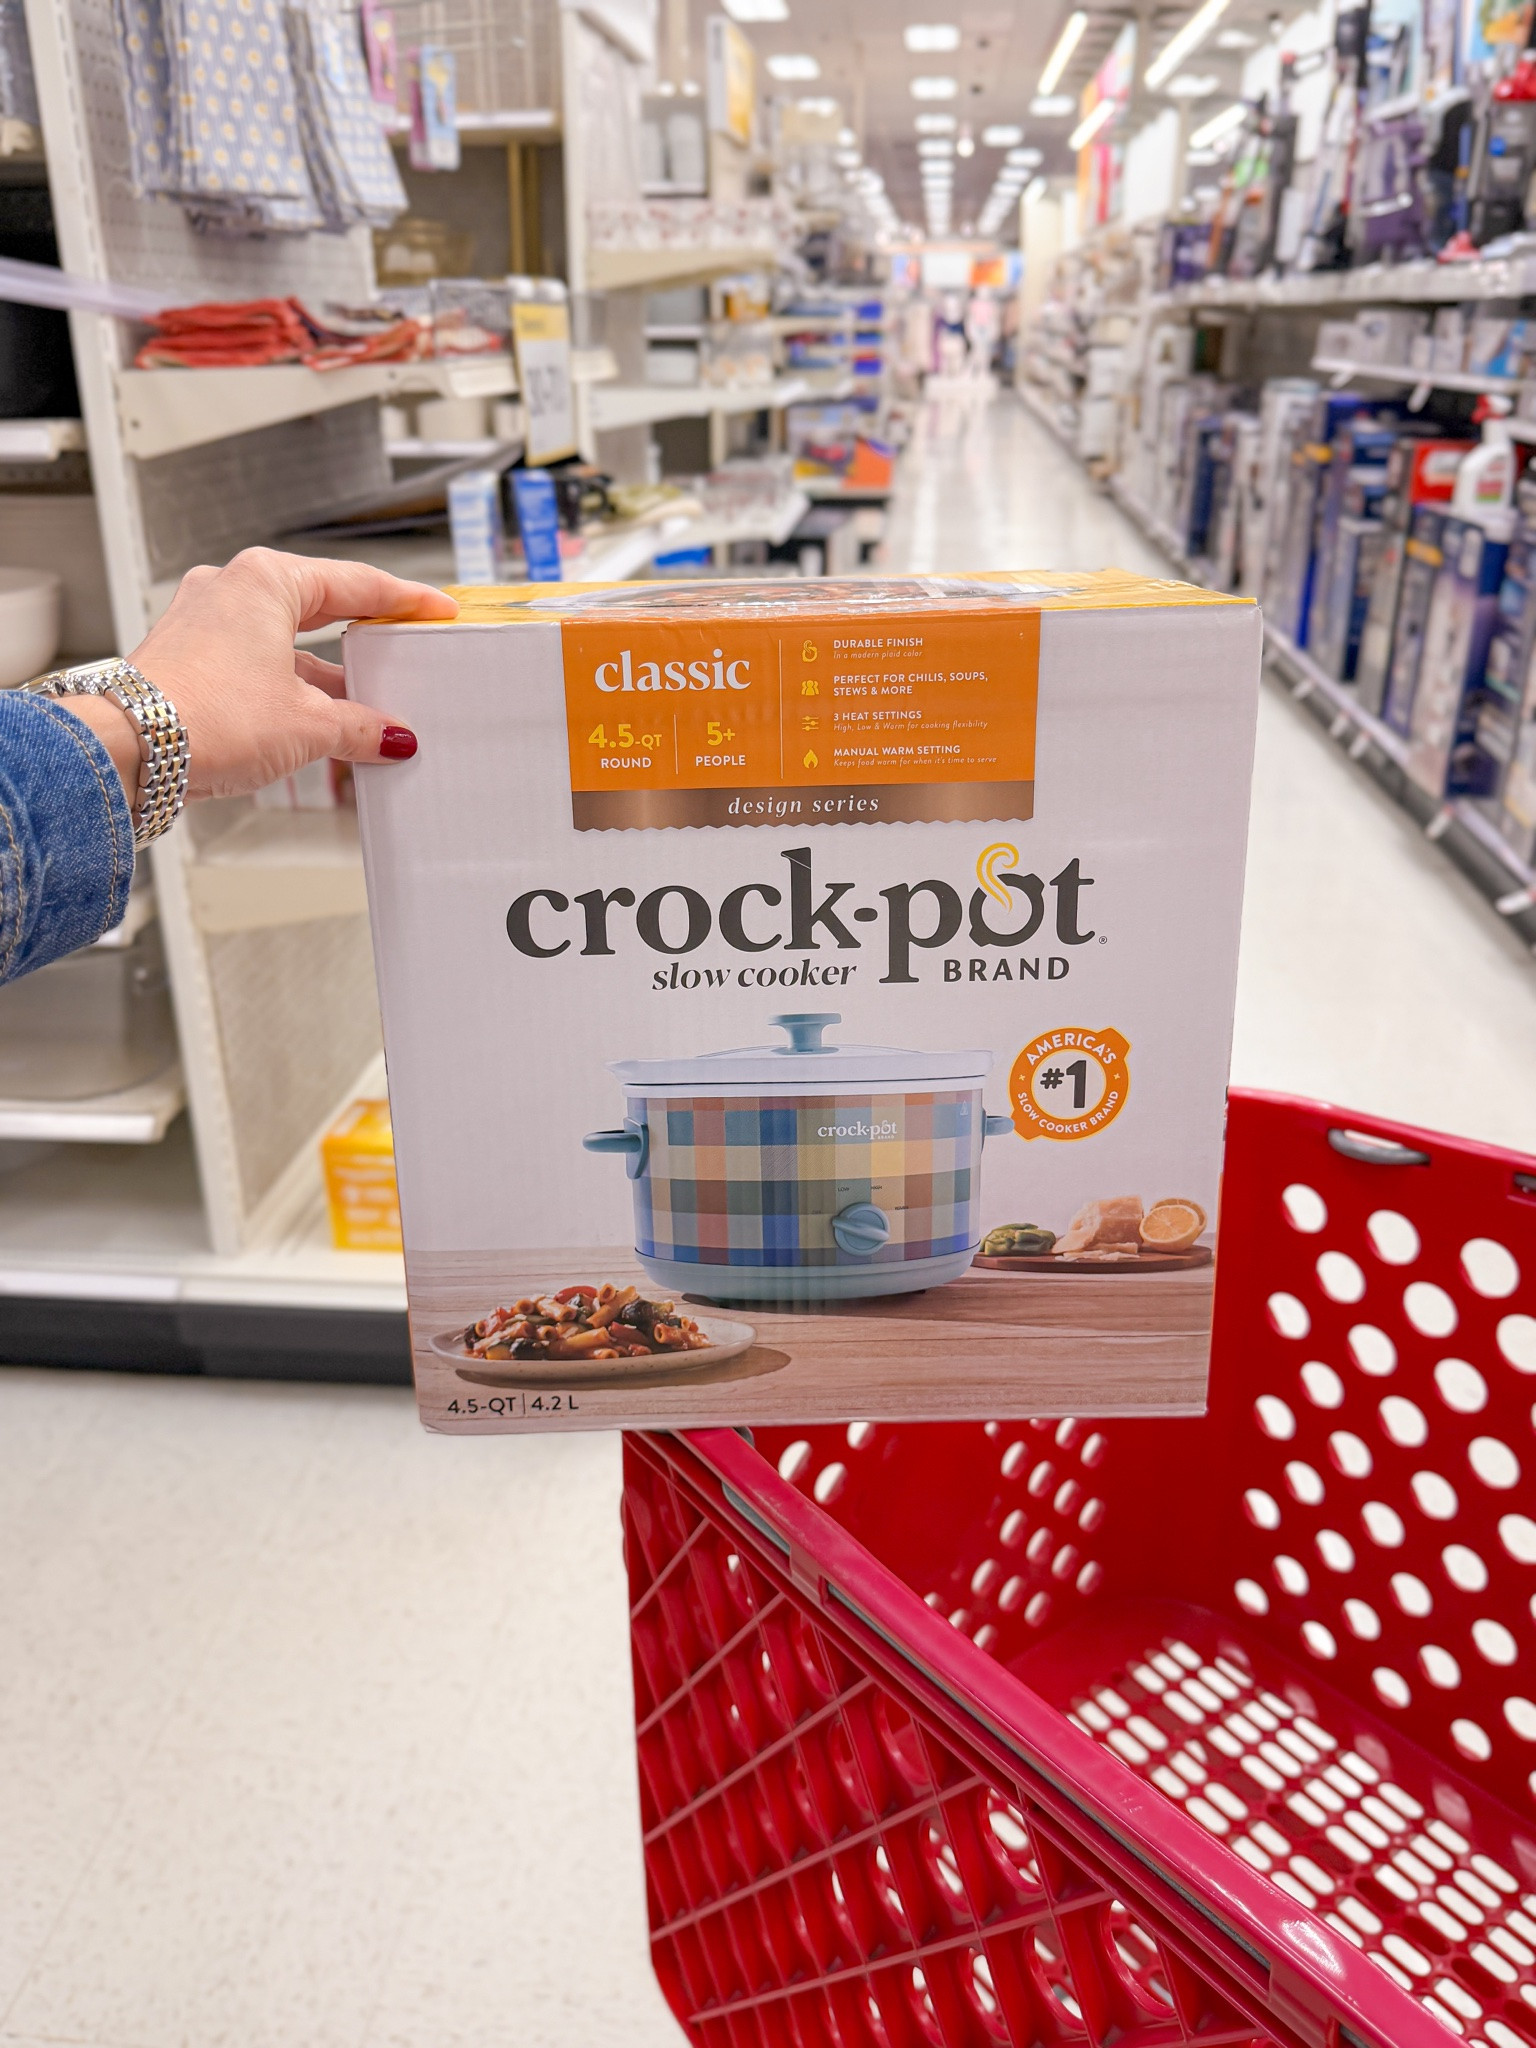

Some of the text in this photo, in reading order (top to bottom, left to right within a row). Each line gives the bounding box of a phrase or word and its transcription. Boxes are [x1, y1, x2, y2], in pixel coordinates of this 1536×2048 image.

[833, 637, 923, 649] DURABLE FINISH
[850, 651, 879, 659] modern
[881, 650, 901, 660] plaid
[594, 648, 752, 692] classic
[833, 671, 988, 684] PERFECT FOR CHILIS, SOUPS,
[833, 686, 913, 697] STEWS & MORE
[833, 710, 922, 721] 3 HEAT SETTINGS
[706, 722, 736, 746] 5+
[833, 723, 855, 733] High,
[857, 723, 872, 731] Low
[874, 722, 880, 730] &
[906, 721, 918, 731] for
[920, 721, 950, 731] cooking
[952, 720, 988, 730] flexibility
[588, 724, 662, 750] 4.5-QT
[833, 745, 961, 757] MANUAL WARM SETTING
[600, 757, 652, 769] ROUND
[695, 755, 746, 767] PEOPLE
[833, 759, 855, 768] Keeps
[857, 758, 874, 769] food
[899, 757, 911, 768] for
[728, 796, 880, 818] design series
[652, 958, 858, 991] slow cooker
[943, 956, 1071, 983] BRAND
[1026, 1032, 1117, 1066] AMERICA'S
[1040, 1060, 1087, 1108] #1
[1018, 1090, 1118, 1133] SLOW COOKER BRAND
[448, 1395, 580, 1416] 4.5-QT 4.2 L
